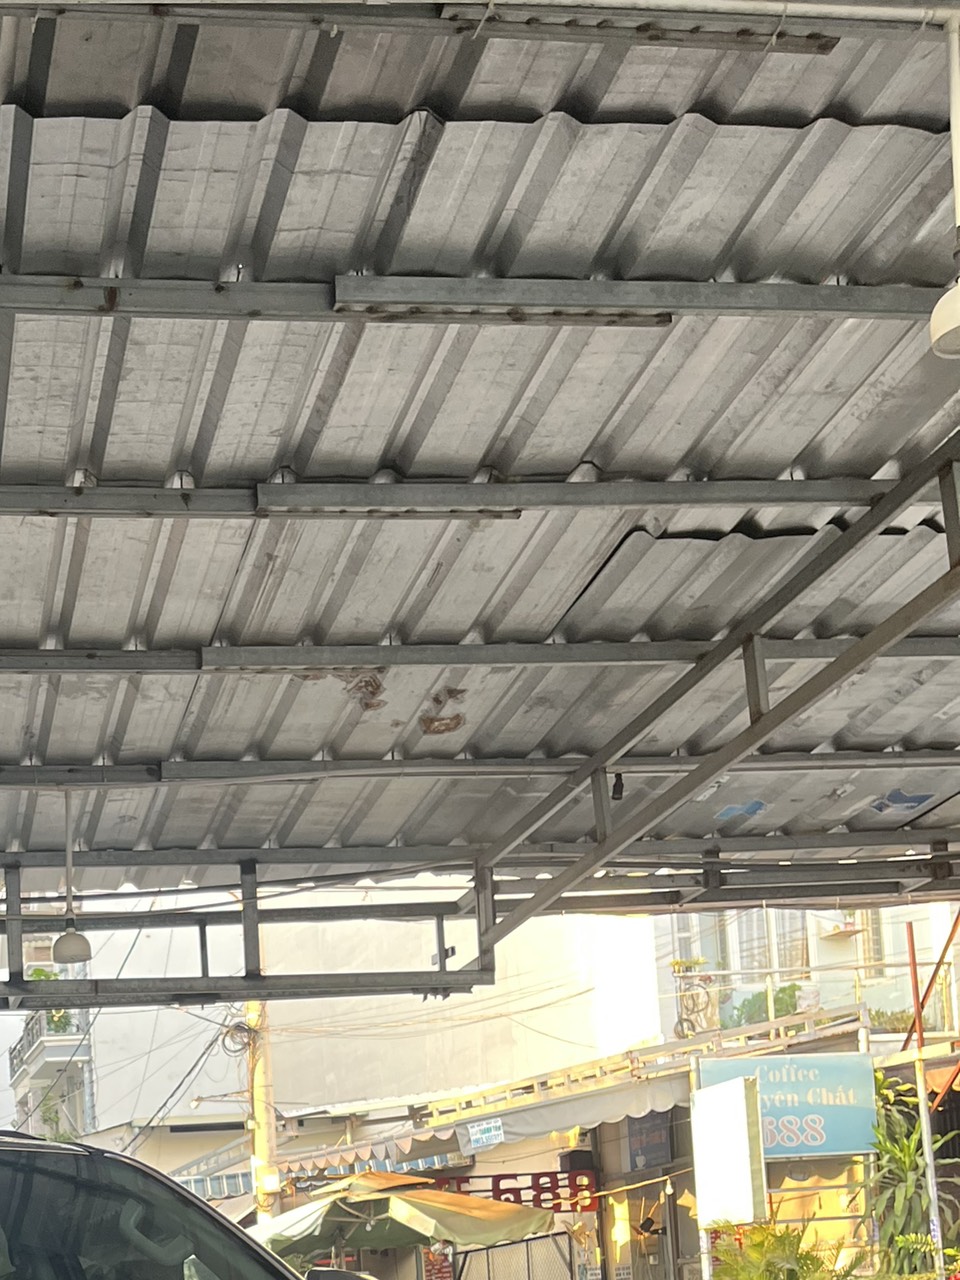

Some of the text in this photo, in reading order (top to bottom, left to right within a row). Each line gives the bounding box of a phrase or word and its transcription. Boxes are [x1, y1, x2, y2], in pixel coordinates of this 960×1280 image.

[754, 1064, 820, 1084] Coffee
[806, 1085, 857, 1106] Chất
[492, 1170, 599, 1213] 688
